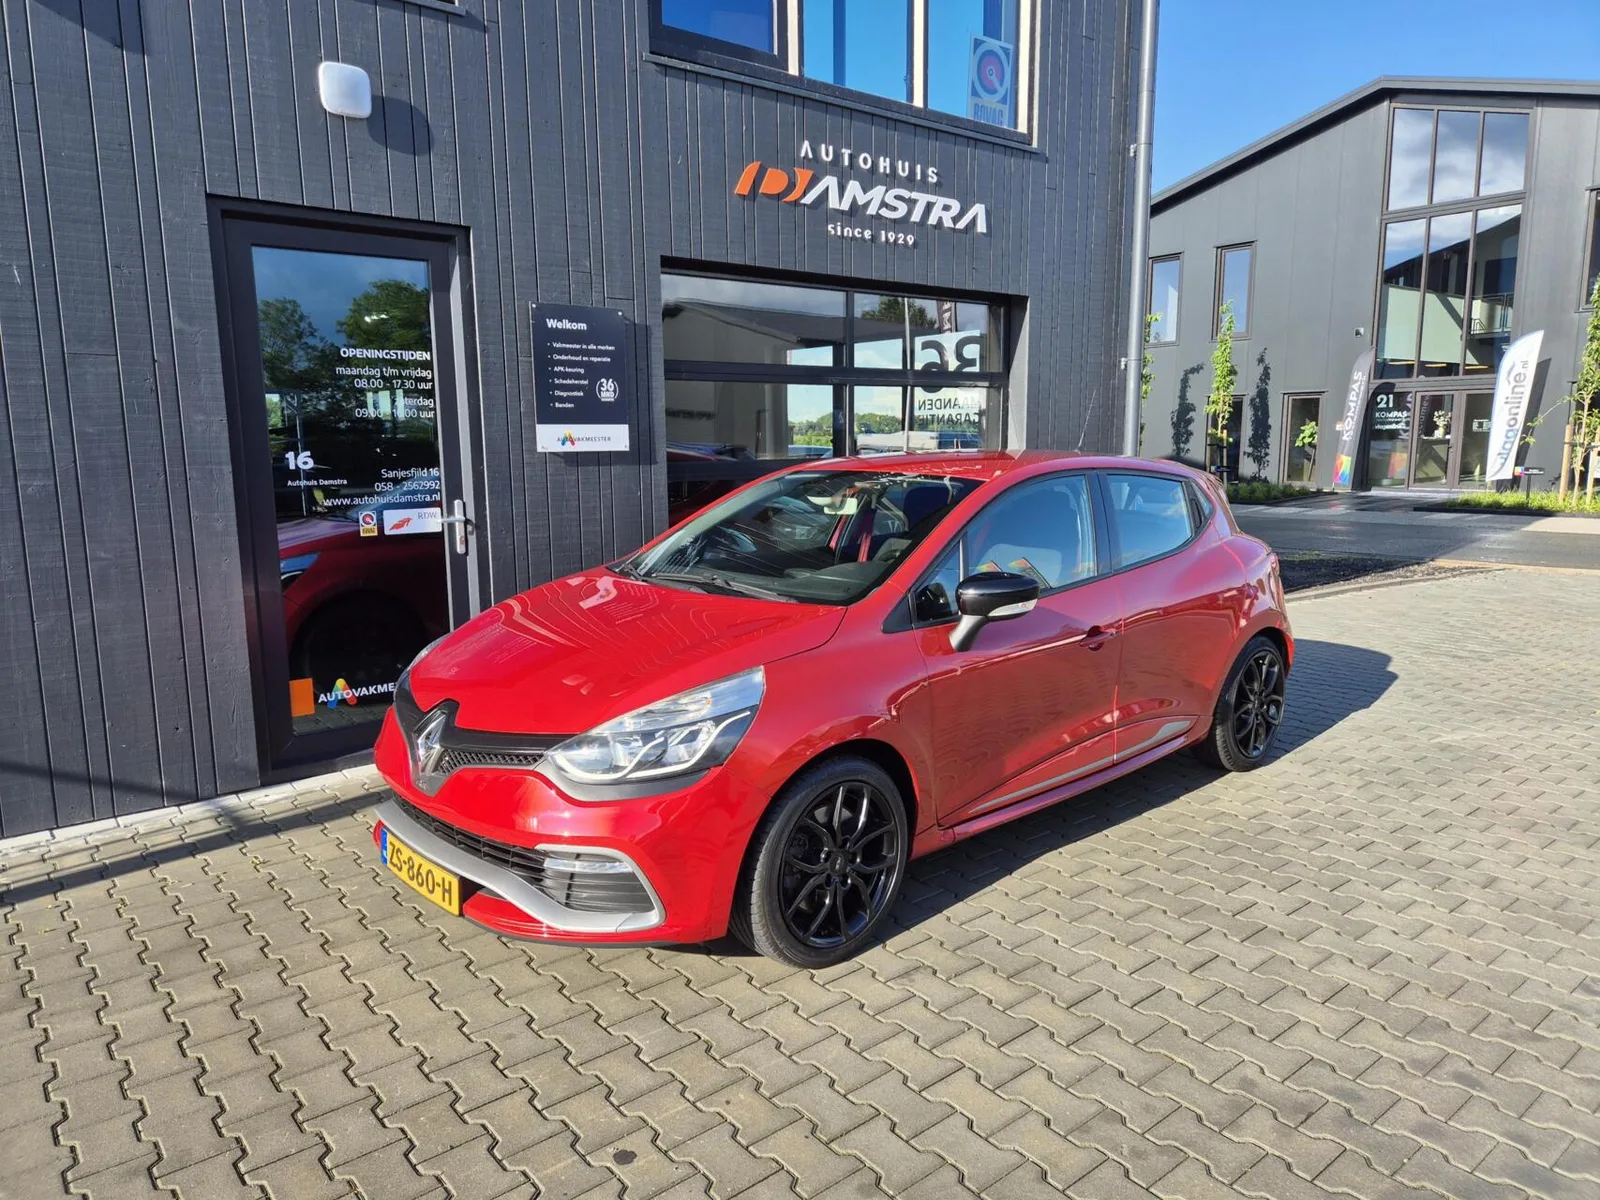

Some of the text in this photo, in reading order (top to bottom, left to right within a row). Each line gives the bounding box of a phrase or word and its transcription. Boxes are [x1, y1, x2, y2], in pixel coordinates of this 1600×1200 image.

[800, 140, 938, 183] AUTOHUIS
[827, 222, 915, 245] since 1929
[546, 318, 587, 330] Welkom
[340, 348, 431, 361] OPENINGSTIJDEN
[336, 365, 432, 379] maandag t/m vrijdag
[354, 378, 383, 388] 08.00
[392, 380, 415, 389] 17.30
[417, 381, 433, 389] uur
[600, 378, 614, 391] 36
[1341, 371, 1363, 440] KOMPAS
[1376, 394, 1393, 408] 21
[419, 410, 435, 418] uur
[1375, 410, 1408, 418] KOMPAS
[285, 450, 314, 470] 16
[381, 467, 440, 479] Sanjesfjild 16
[287, 478, 348, 487] Autohuis Damstra
[374, 482, 394, 492] 058
[402, 481, 440, 490] 2562992
[323, 492, 440, 506] www.autohuisdamstra.nl
[417, 511, 437, 520] RDW
[318, 682, 398, 703] AUTOVAKME
[388, 841, 452, 906] ZS-860-H
